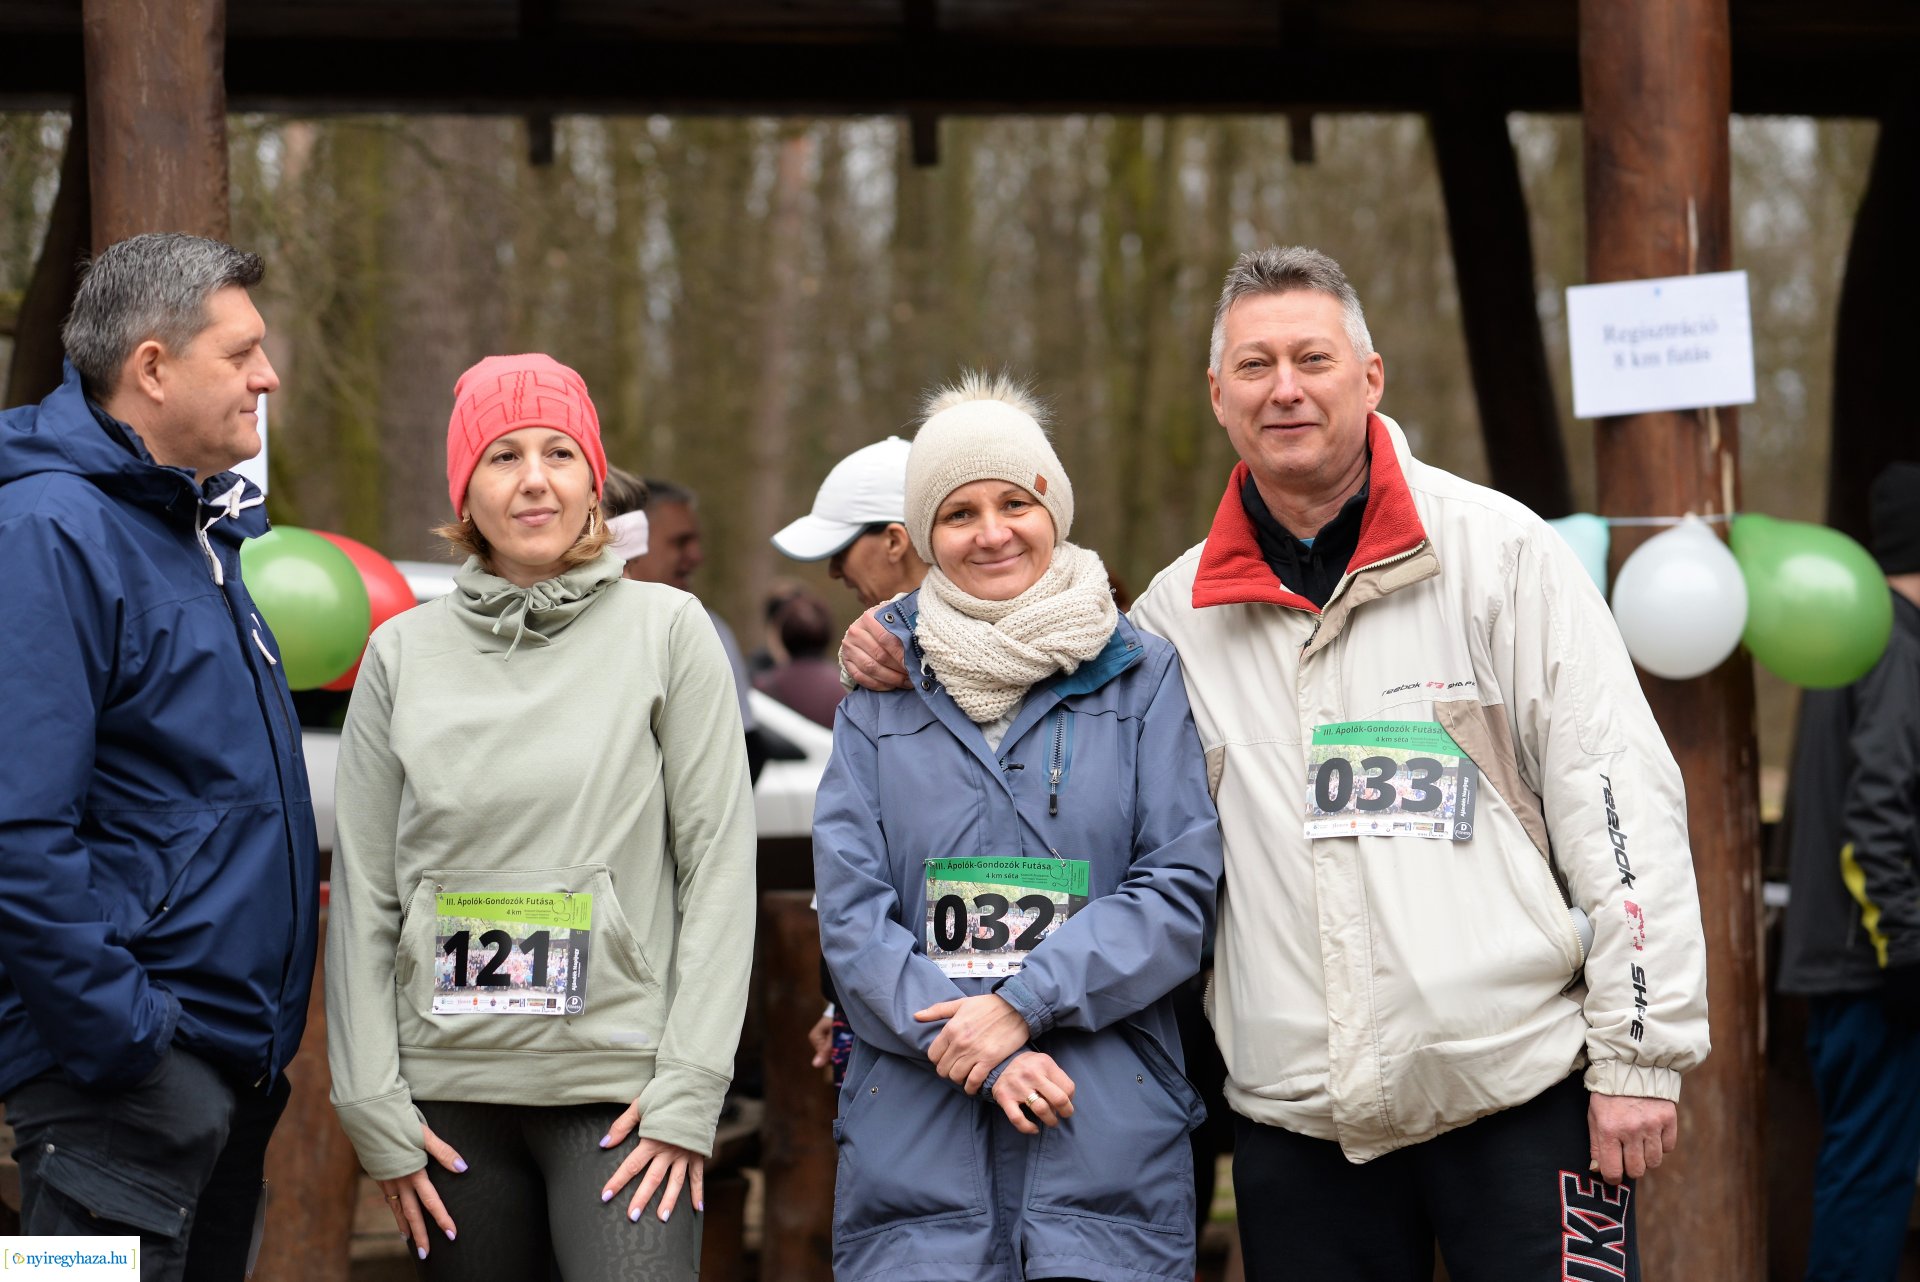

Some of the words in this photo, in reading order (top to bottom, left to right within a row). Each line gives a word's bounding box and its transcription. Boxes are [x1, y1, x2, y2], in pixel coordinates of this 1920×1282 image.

[1603, 317, 1719, 344] Regisztráció
[1631, 351, 1661, 367] km
[1667, 346, 1711, 365] futás
[1381, 682, 1421, 696] reebok
[1323, 728, 1334, 736] III.
[1335, 725, 1410, 736] Ápolók-Gondozók
[1413, 726, 1442, 735] Futása
[1315, 756, 1444, 813] 033
[1460, 823, 1468, 831] D
[1599, 772, 1637, 890] reebok
[948, 860, 1020, 872] Ápolók-Gondozók
[1022, 862, 1051, 870] Futása
[446, 898, 456, 906] III.
[457, 896, 524, 907] Ápolók-Gondozók
[526, 897, 554, 906] Futása
[933, 893, 1055, 952] 032
[442, 929, 550, 987] 121
[571, 997, 578, 1005] D
[1630, 962, 1648, 1043] SHE
[1559, 1170, 1630, 1282] IKE
